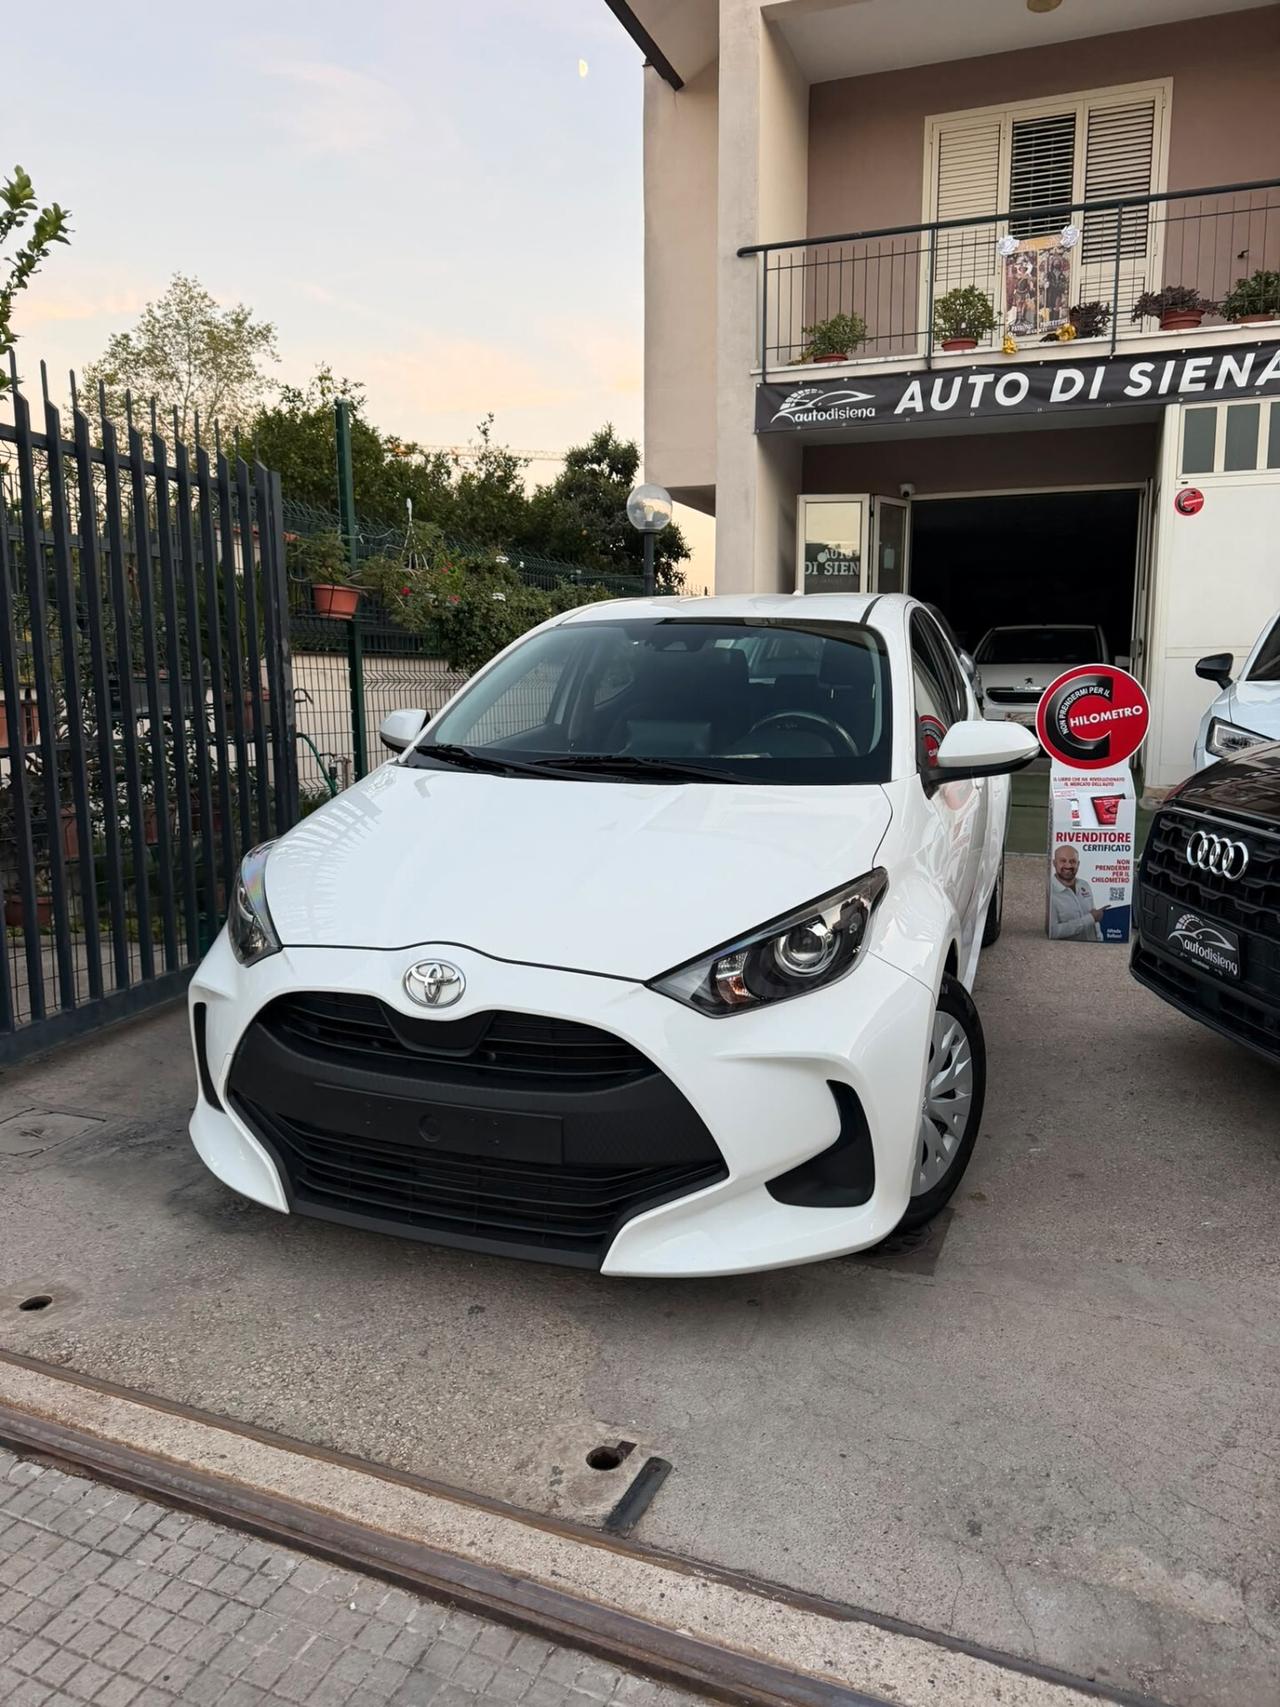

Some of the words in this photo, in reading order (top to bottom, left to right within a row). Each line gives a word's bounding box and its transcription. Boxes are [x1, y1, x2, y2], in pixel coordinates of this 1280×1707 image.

[894, 371, 1029, 415] AUTO
[1049, 365, 1107, 403] DI
[1123, 350, 1280, 397] SIENA
[794, 405, 876, 423] autodisiena
[805, 561, 819, 575] DI
[1089, 686, 1104, 694] PER
[1103, 689, 1111, 698] IL
[1059, 687, 1088, 719] PRENDERMI
[1059, 719, 1070, 735] NON
[1056, 832, 1131, 843] RIVENDITORE
[1082, 844, 1131, 852] CERTIFICATO
[1184, 939, 1238, 976] autodisiena
